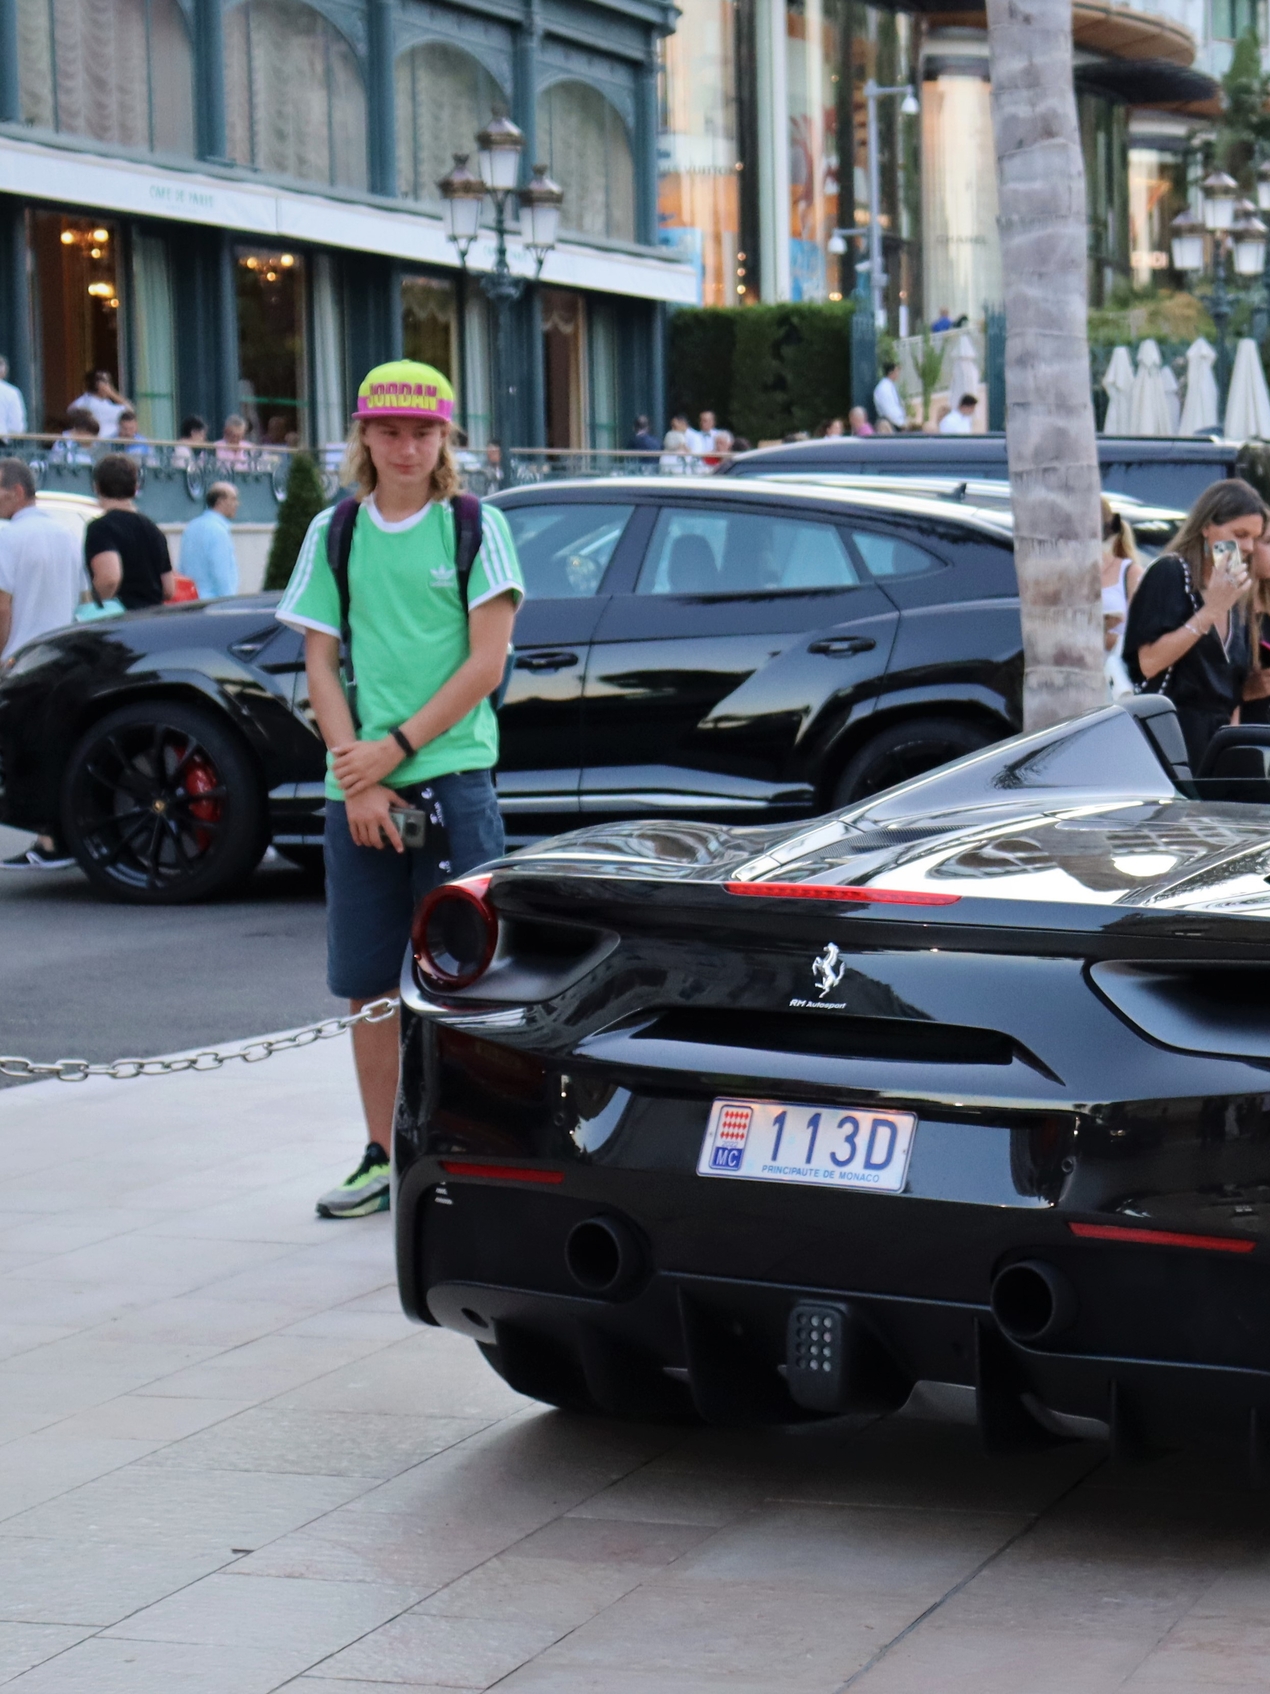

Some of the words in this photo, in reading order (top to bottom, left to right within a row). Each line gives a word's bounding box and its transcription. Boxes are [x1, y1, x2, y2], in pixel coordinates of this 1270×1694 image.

[367, 382, 438, 411] JORDAN
[805, 1000, 847, 1010] Autosport
[771, 1110, 898, 1171] 113D
[715, 1148, 738, 1166] MC
[761, 1164, 820, 1179] PRINCIPAUTE
[822, 1168, 836, 1180] DE
[838, 1171, 881, 1184] MONACO
